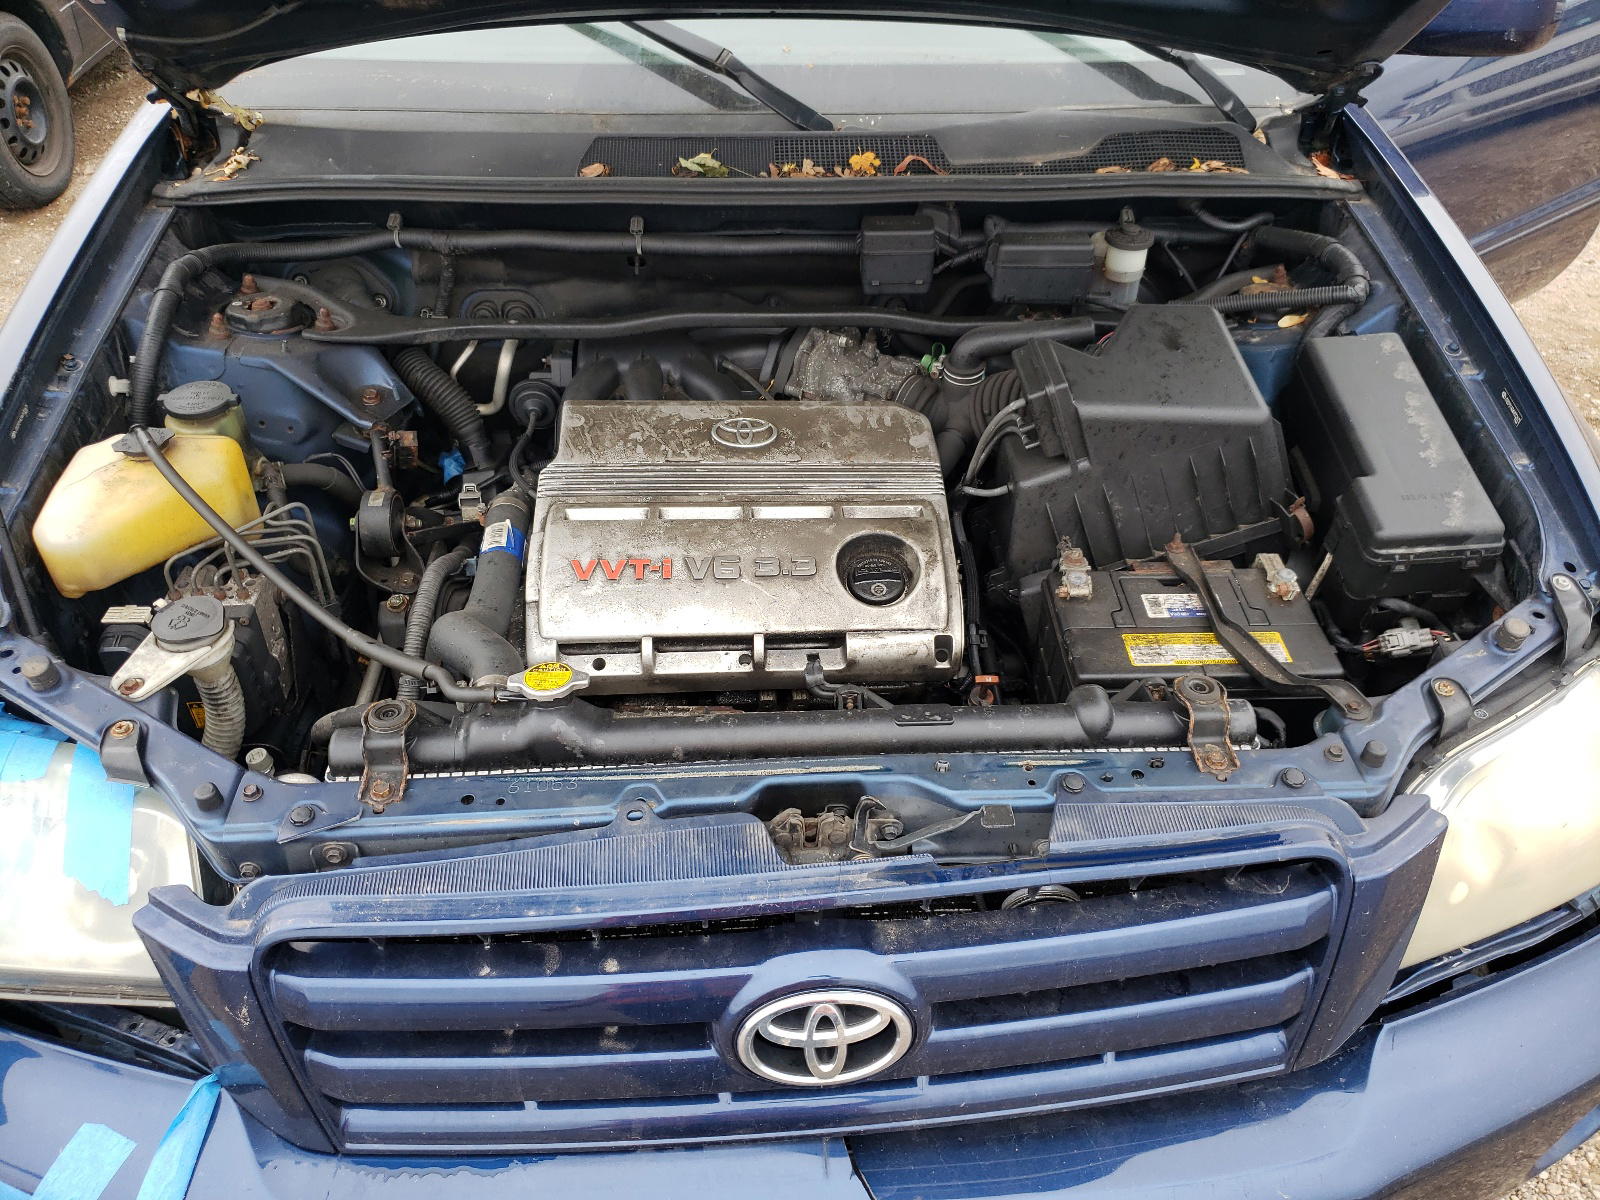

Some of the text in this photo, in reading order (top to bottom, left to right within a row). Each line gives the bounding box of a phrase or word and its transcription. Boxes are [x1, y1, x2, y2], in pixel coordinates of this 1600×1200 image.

[571, 555, 818, 581] VVT-i V6 3.3
